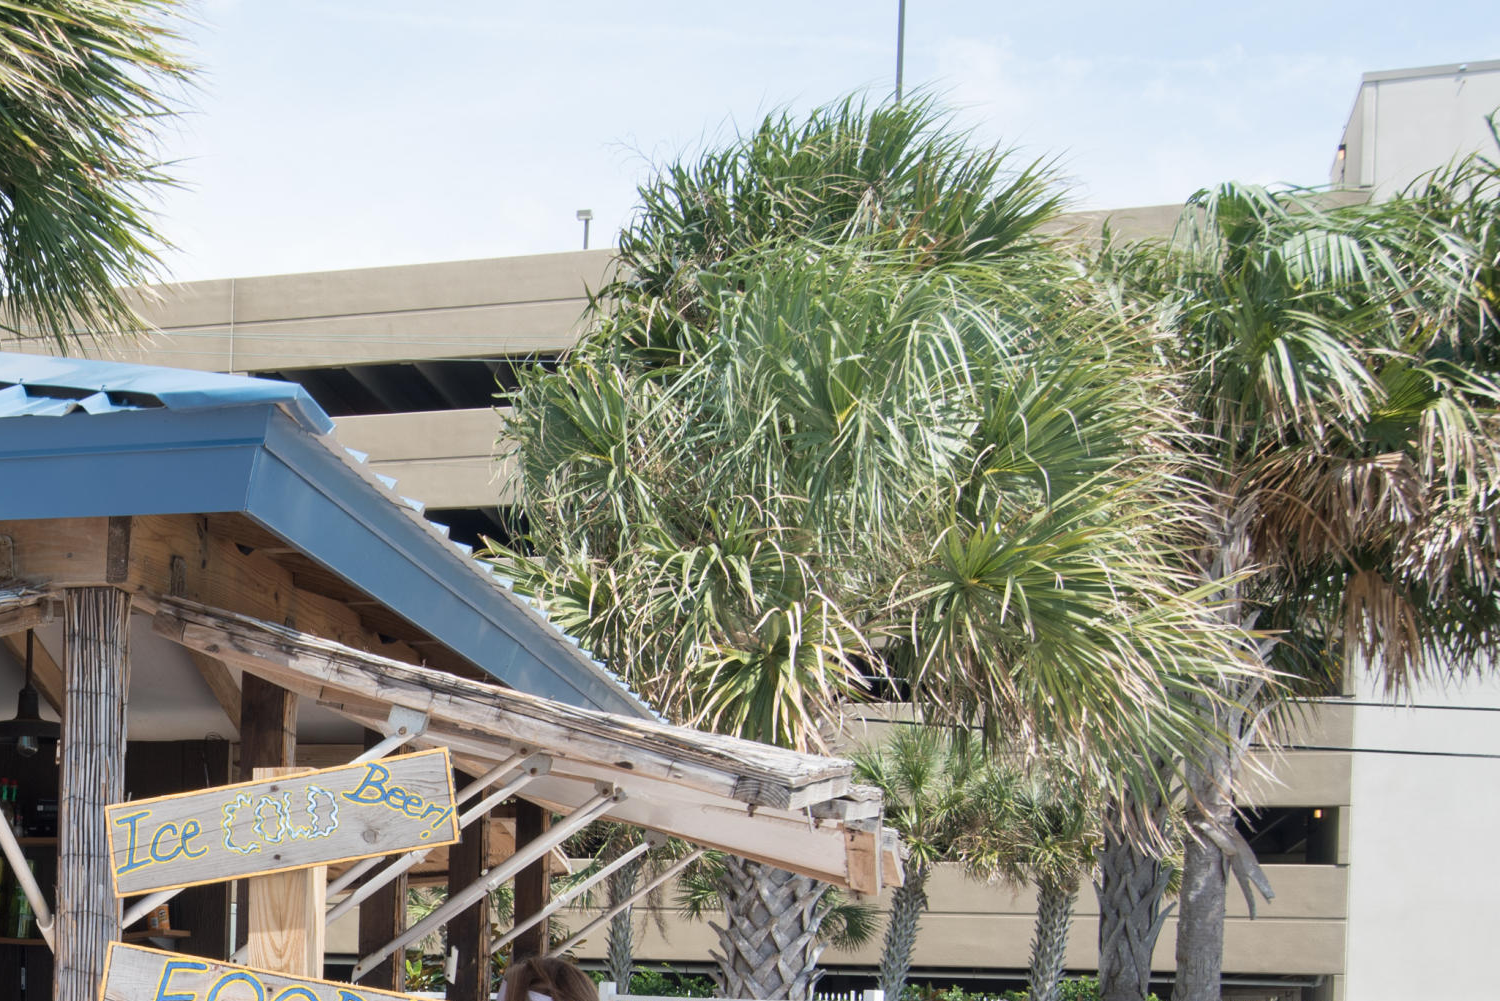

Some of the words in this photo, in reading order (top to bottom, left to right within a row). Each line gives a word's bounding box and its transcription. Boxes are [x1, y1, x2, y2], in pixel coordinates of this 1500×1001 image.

[115, 810, 209, 877] Ice
[222, 783, 339, 855] COLD
[342, 762, 454, 839] Beer!
